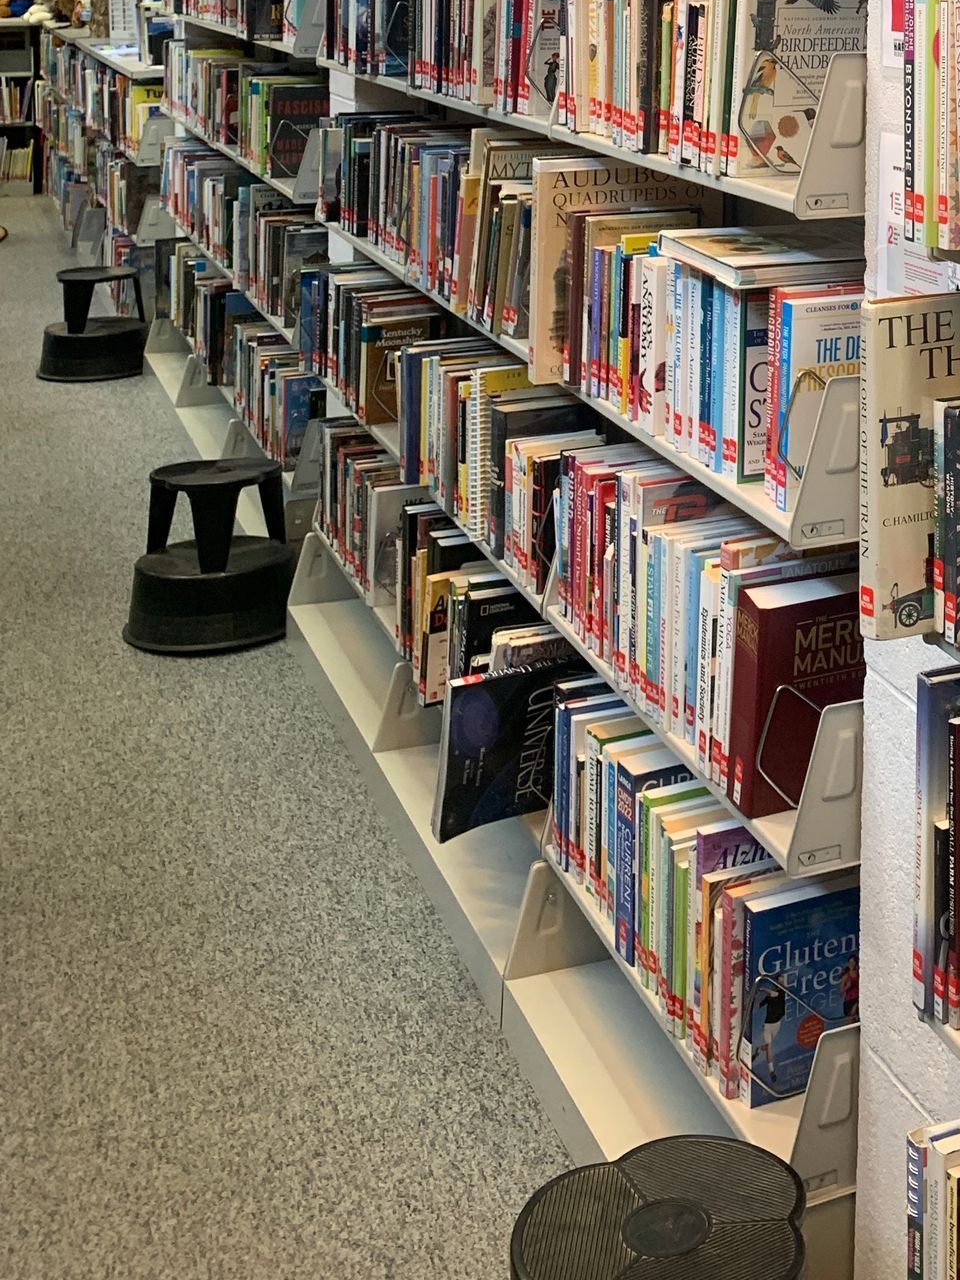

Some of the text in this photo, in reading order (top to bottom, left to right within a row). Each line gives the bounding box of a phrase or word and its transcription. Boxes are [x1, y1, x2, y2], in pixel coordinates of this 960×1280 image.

[780, 37, 861, 52] BIRDFEEDER
[783, 24, 861, 36] North American
[904, 64, 912, 134] BEYOND
[552, 186, 678, 211] QUADRUPEDS
[805, 304, 839, 313] CLEANSES
[380, 327, 423, 344] Kentucky
[674, 315, 682, 368] SHALLOWS
[768, 294, 776, 363] DANGEROUS
[878, 310, 956, 349] THE
[816, 336, 840, 364] THE
[860, 375, 870, 559] LORE TRAIN
[622, 828, 634, 912] CURRENT
[757, 935, 858, 977] Gluten
[783, 968, 842, 992] Free
